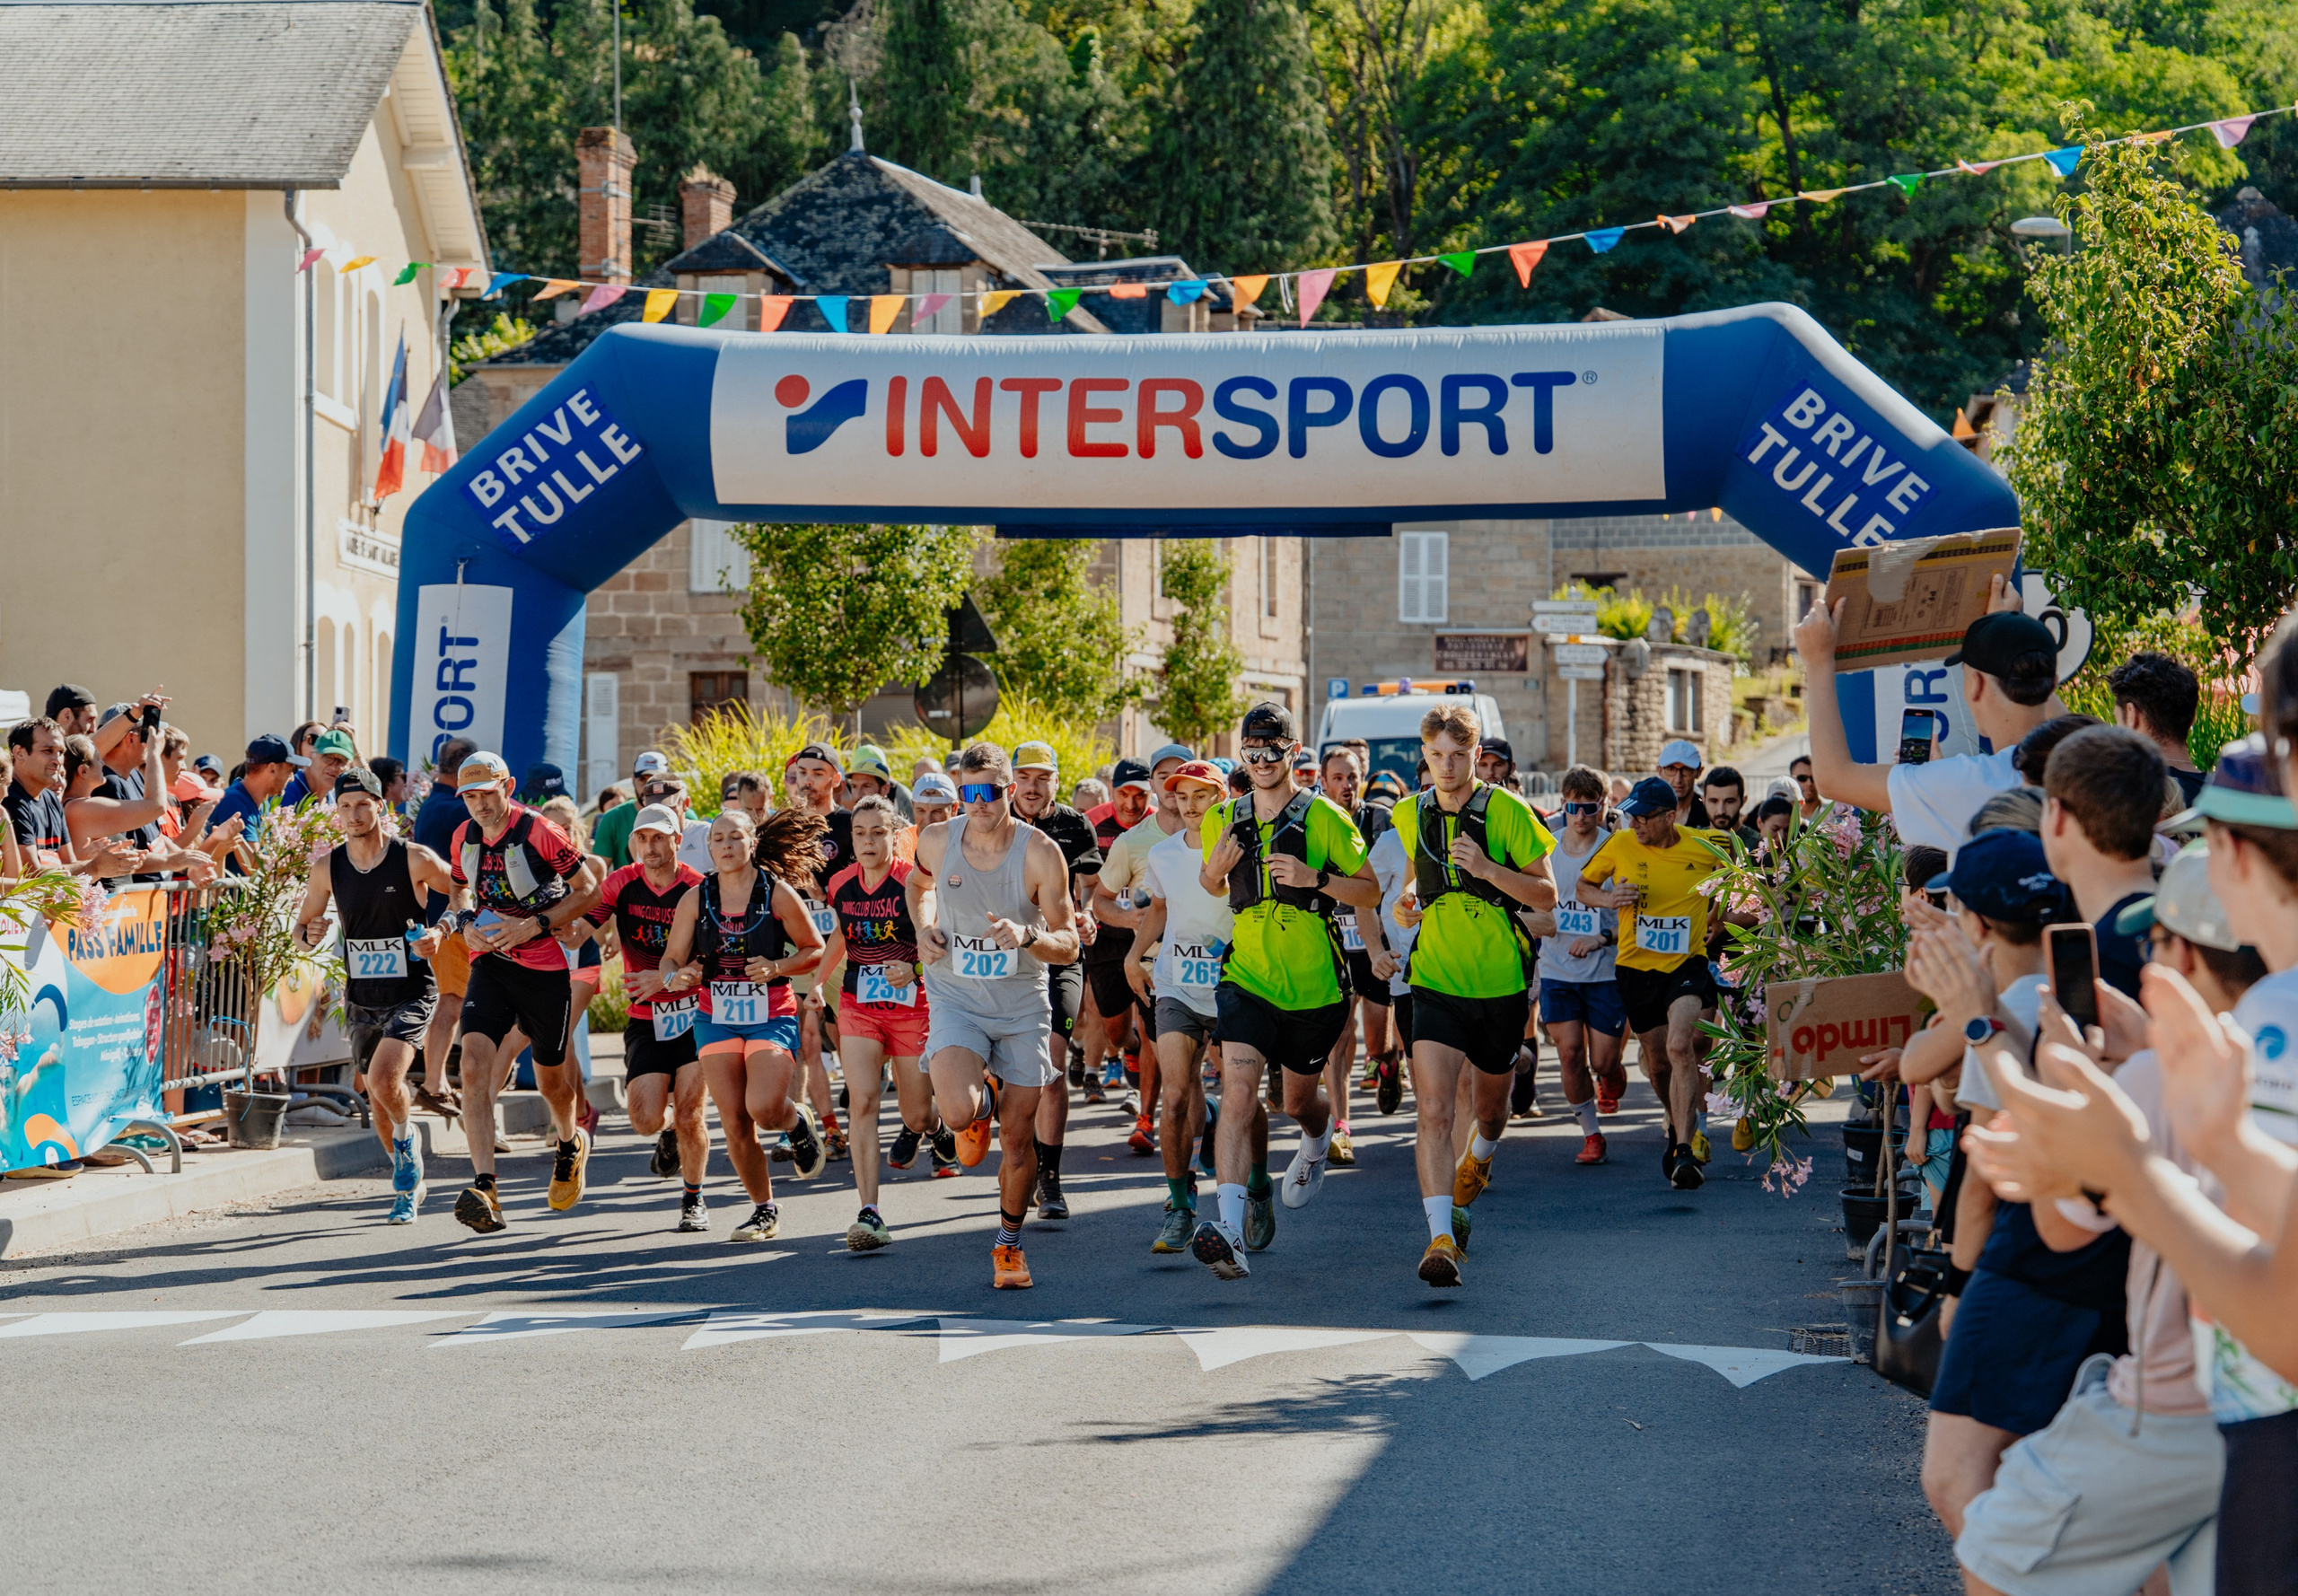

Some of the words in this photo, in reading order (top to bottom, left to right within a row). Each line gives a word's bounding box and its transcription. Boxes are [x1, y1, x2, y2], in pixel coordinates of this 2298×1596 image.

[885, 370, 1577, 460] INTERSPORT
[469, 389, 601, 509] BRIVE
[1782, 388, 1931, 515] BRIVE
[491, 423, 643, 544] TULLE
[464, 769, 482, 778] ciele
[645, 906, 661, 921] CLUB
[855, 901, 871, 916] CLUB
[871, 896, 900, 917] USSAC
[1554, 900, 1598, 914] MLK
[1559, 912, 1592, 933] 243
[1638, 916, 1688, 930] MLK
[105, 921, 162, 958] FAMILLE
[349, 939, 402, 952] MLK
[1645, 930, 1680, 951] 201
[359, 953, 398, 976] 222
[961, 951, 1008, 977] 202
[1180, 960, 1221, 984] 265
[712, 983, 767, 996] MLK
[723, 998, 756, 1022] 211
[69, 1019, 87, 1031] Stages
